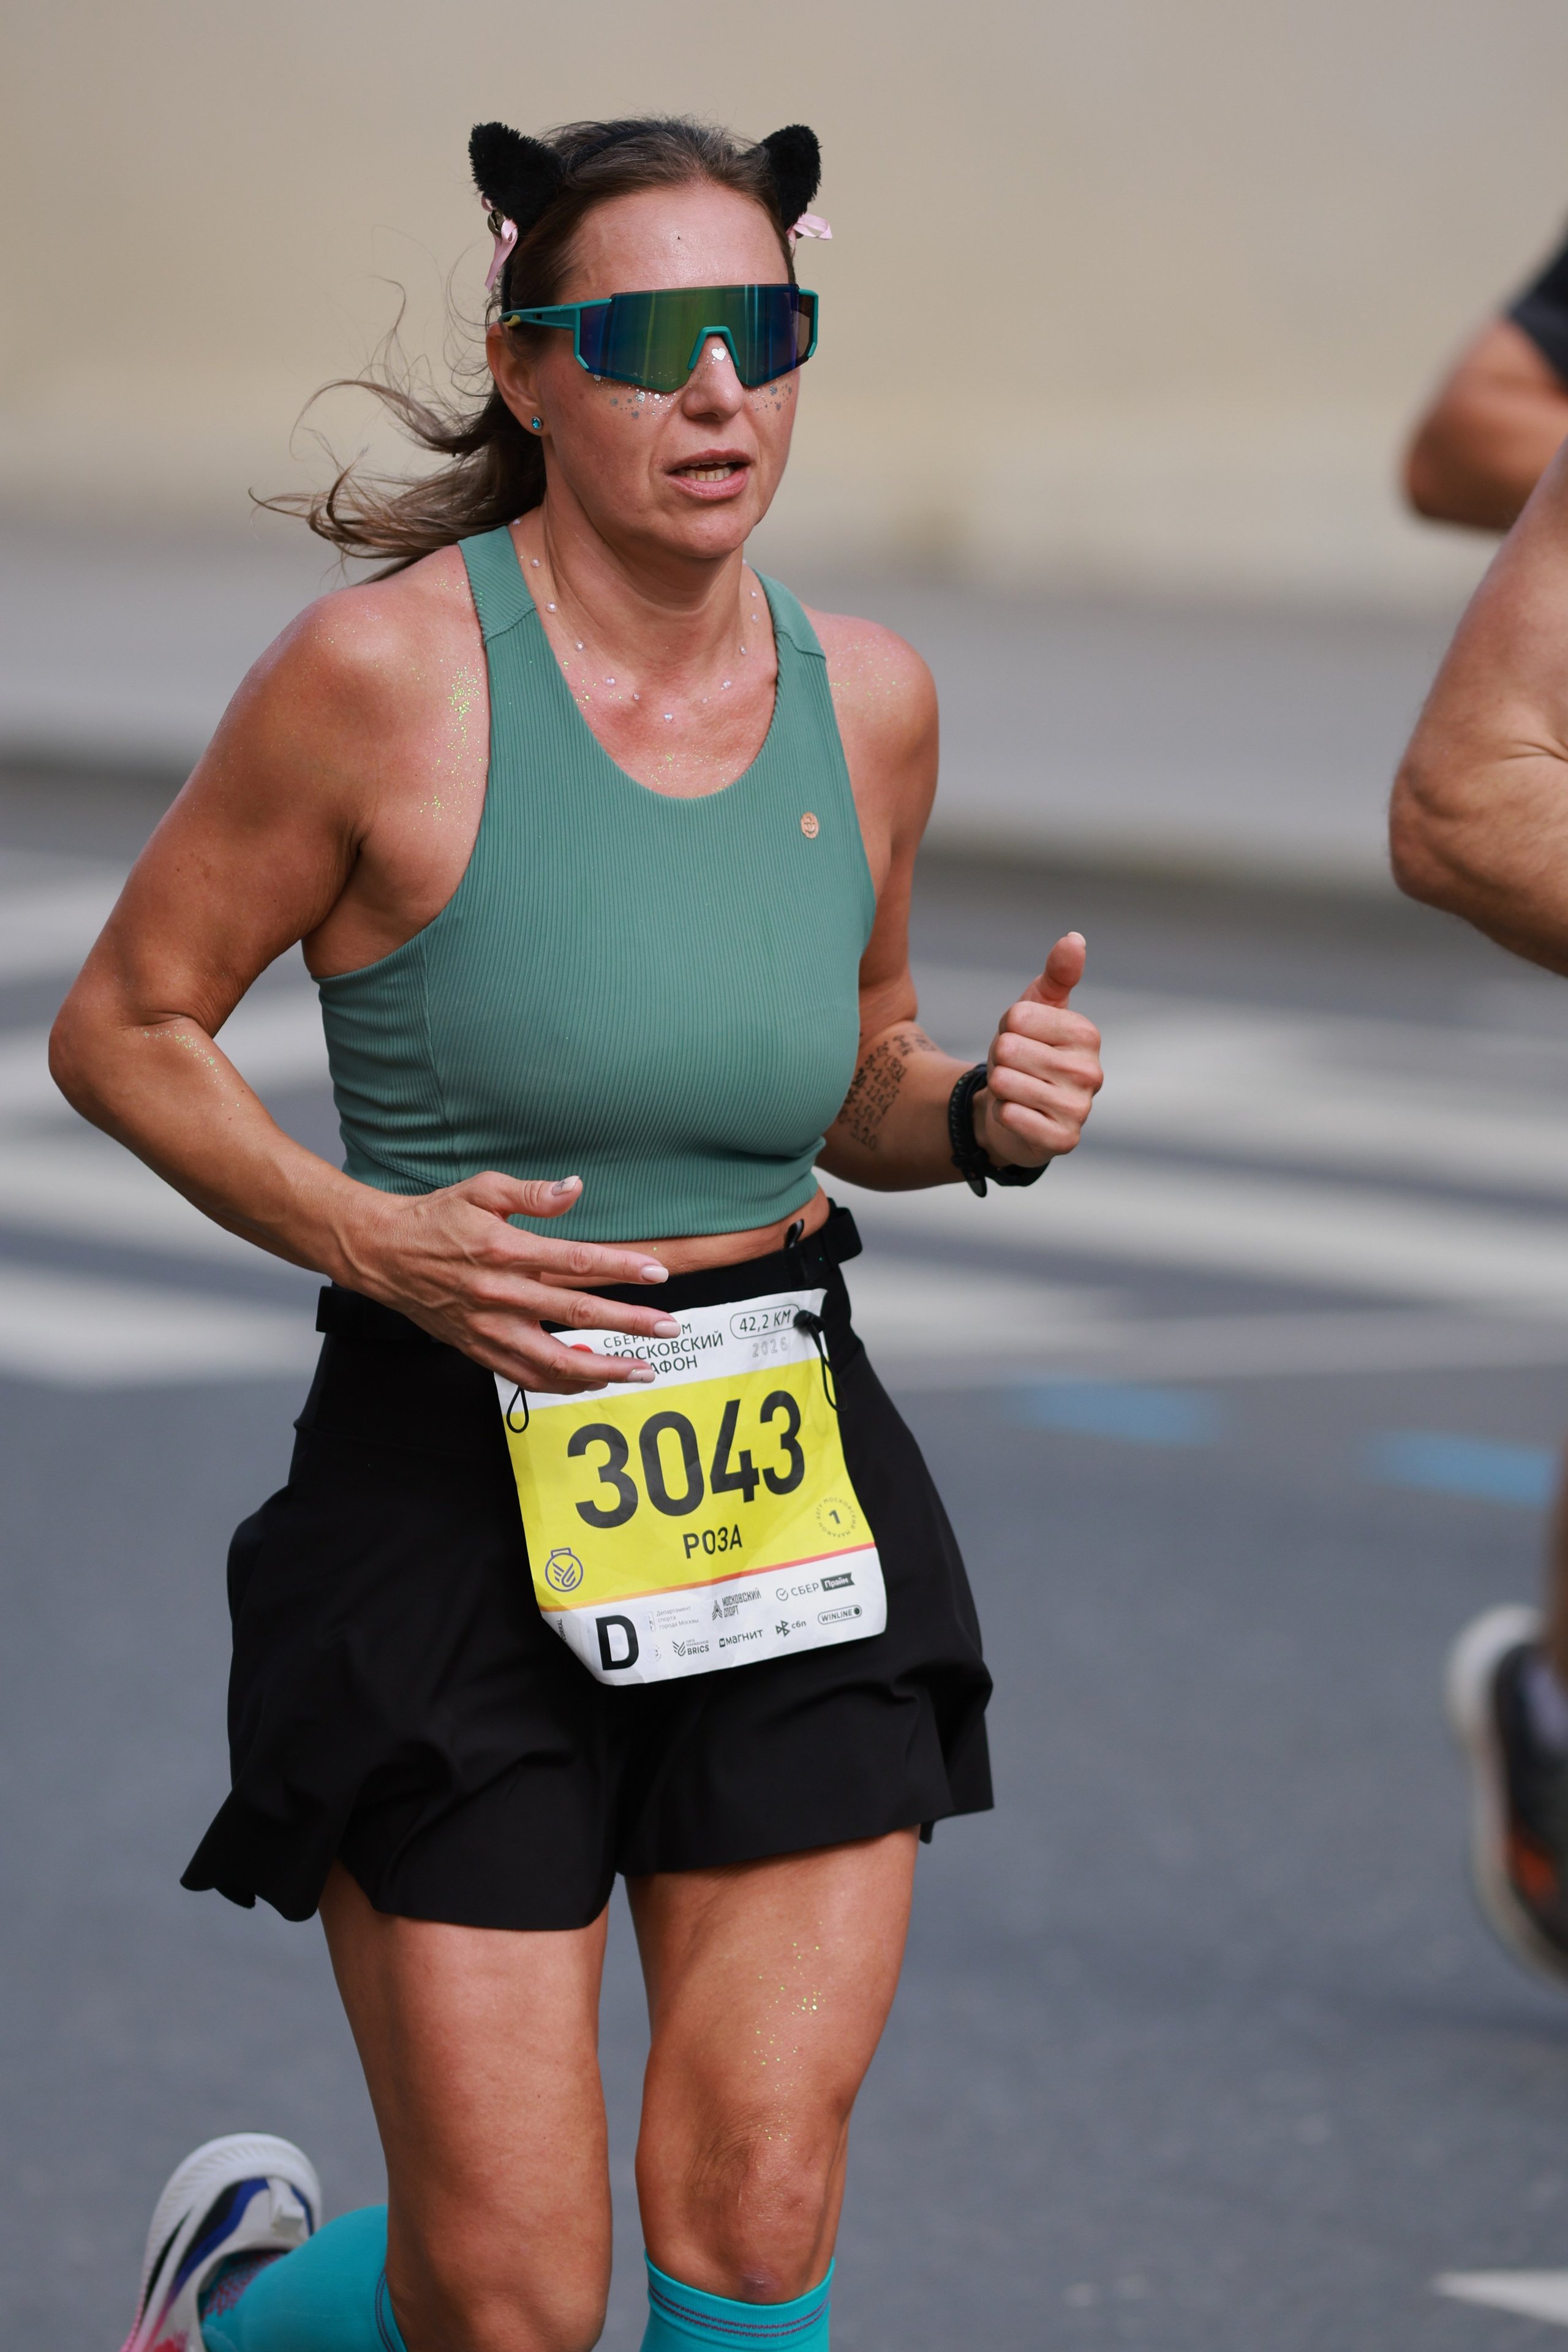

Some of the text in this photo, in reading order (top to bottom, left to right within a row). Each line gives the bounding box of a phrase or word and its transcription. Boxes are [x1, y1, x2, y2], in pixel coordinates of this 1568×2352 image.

[739, 1314, 769, 1333] 42,2
[752, 1336, 788, 1358] 2026
[567, 1390, 805, 1529] 3043
[828, 1509, 841, 1525] 1
[682, 1524, 743, 1559] РОЗА
[791, 1576, 850, 1596] СБЕР Прайм
[722, 1588, 762, 1607] МОСКОВСКИЙ
[657, 1606, 691, 1617] Департамент
[723, 1605, 739, 1618] СПОРТ
[821, 1609, 853, 1623] WINLINE
[557, 1618, 567, 1641] CORRAL
[595, 1615, 639, 1671] D
[687, 1645, 709, 1655] BRICS
